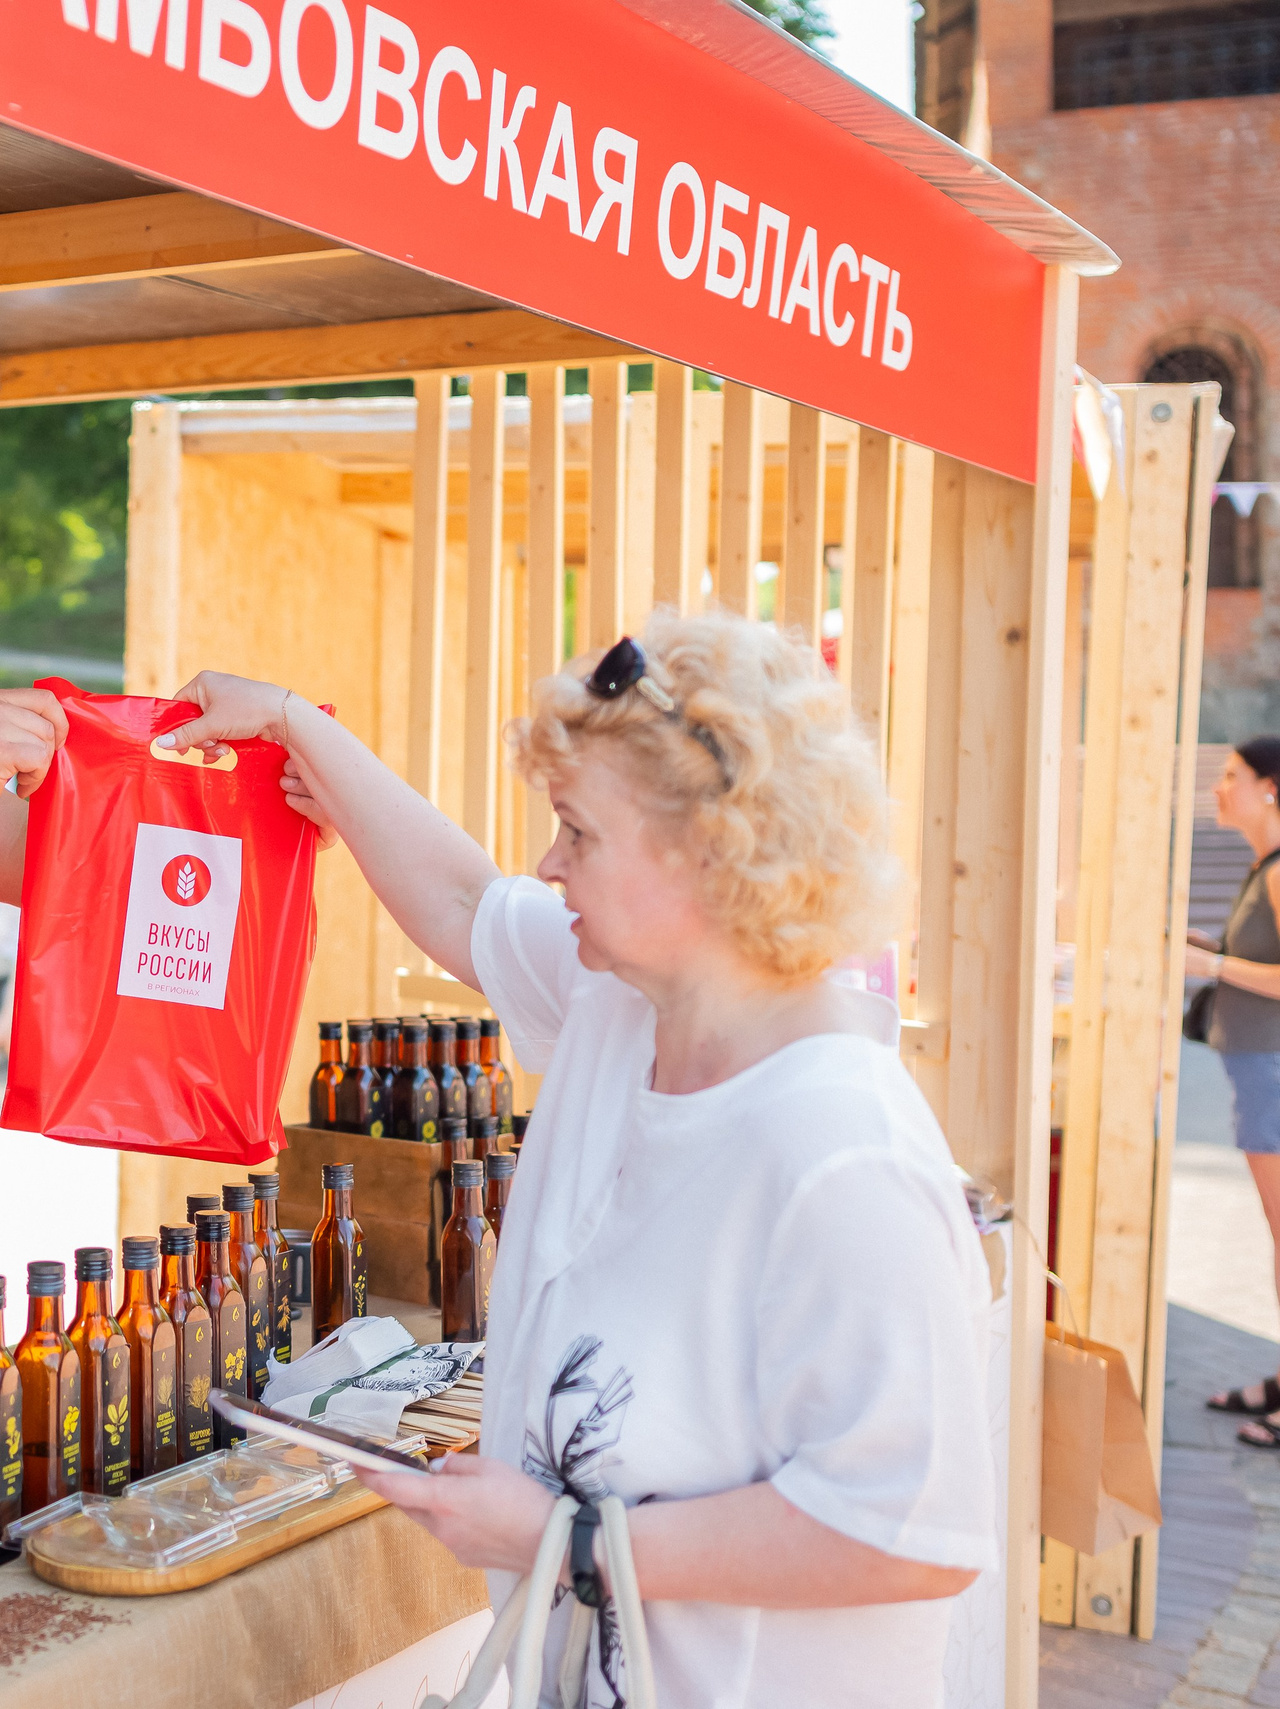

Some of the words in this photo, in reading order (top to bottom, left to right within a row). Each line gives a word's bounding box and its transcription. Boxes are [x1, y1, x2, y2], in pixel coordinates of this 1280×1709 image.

[60, 0, 639, 257] БОВСКАЯ
[657, 160, 914, 373] ОБЛАСТЬ
[147, 922, 210, 953] ВКУСЫ
[137, 952, 212, 984] РОССИИ
[147, 982, 154, 991] В
[154, 983, 200, 997] РЕГИОНАХ
